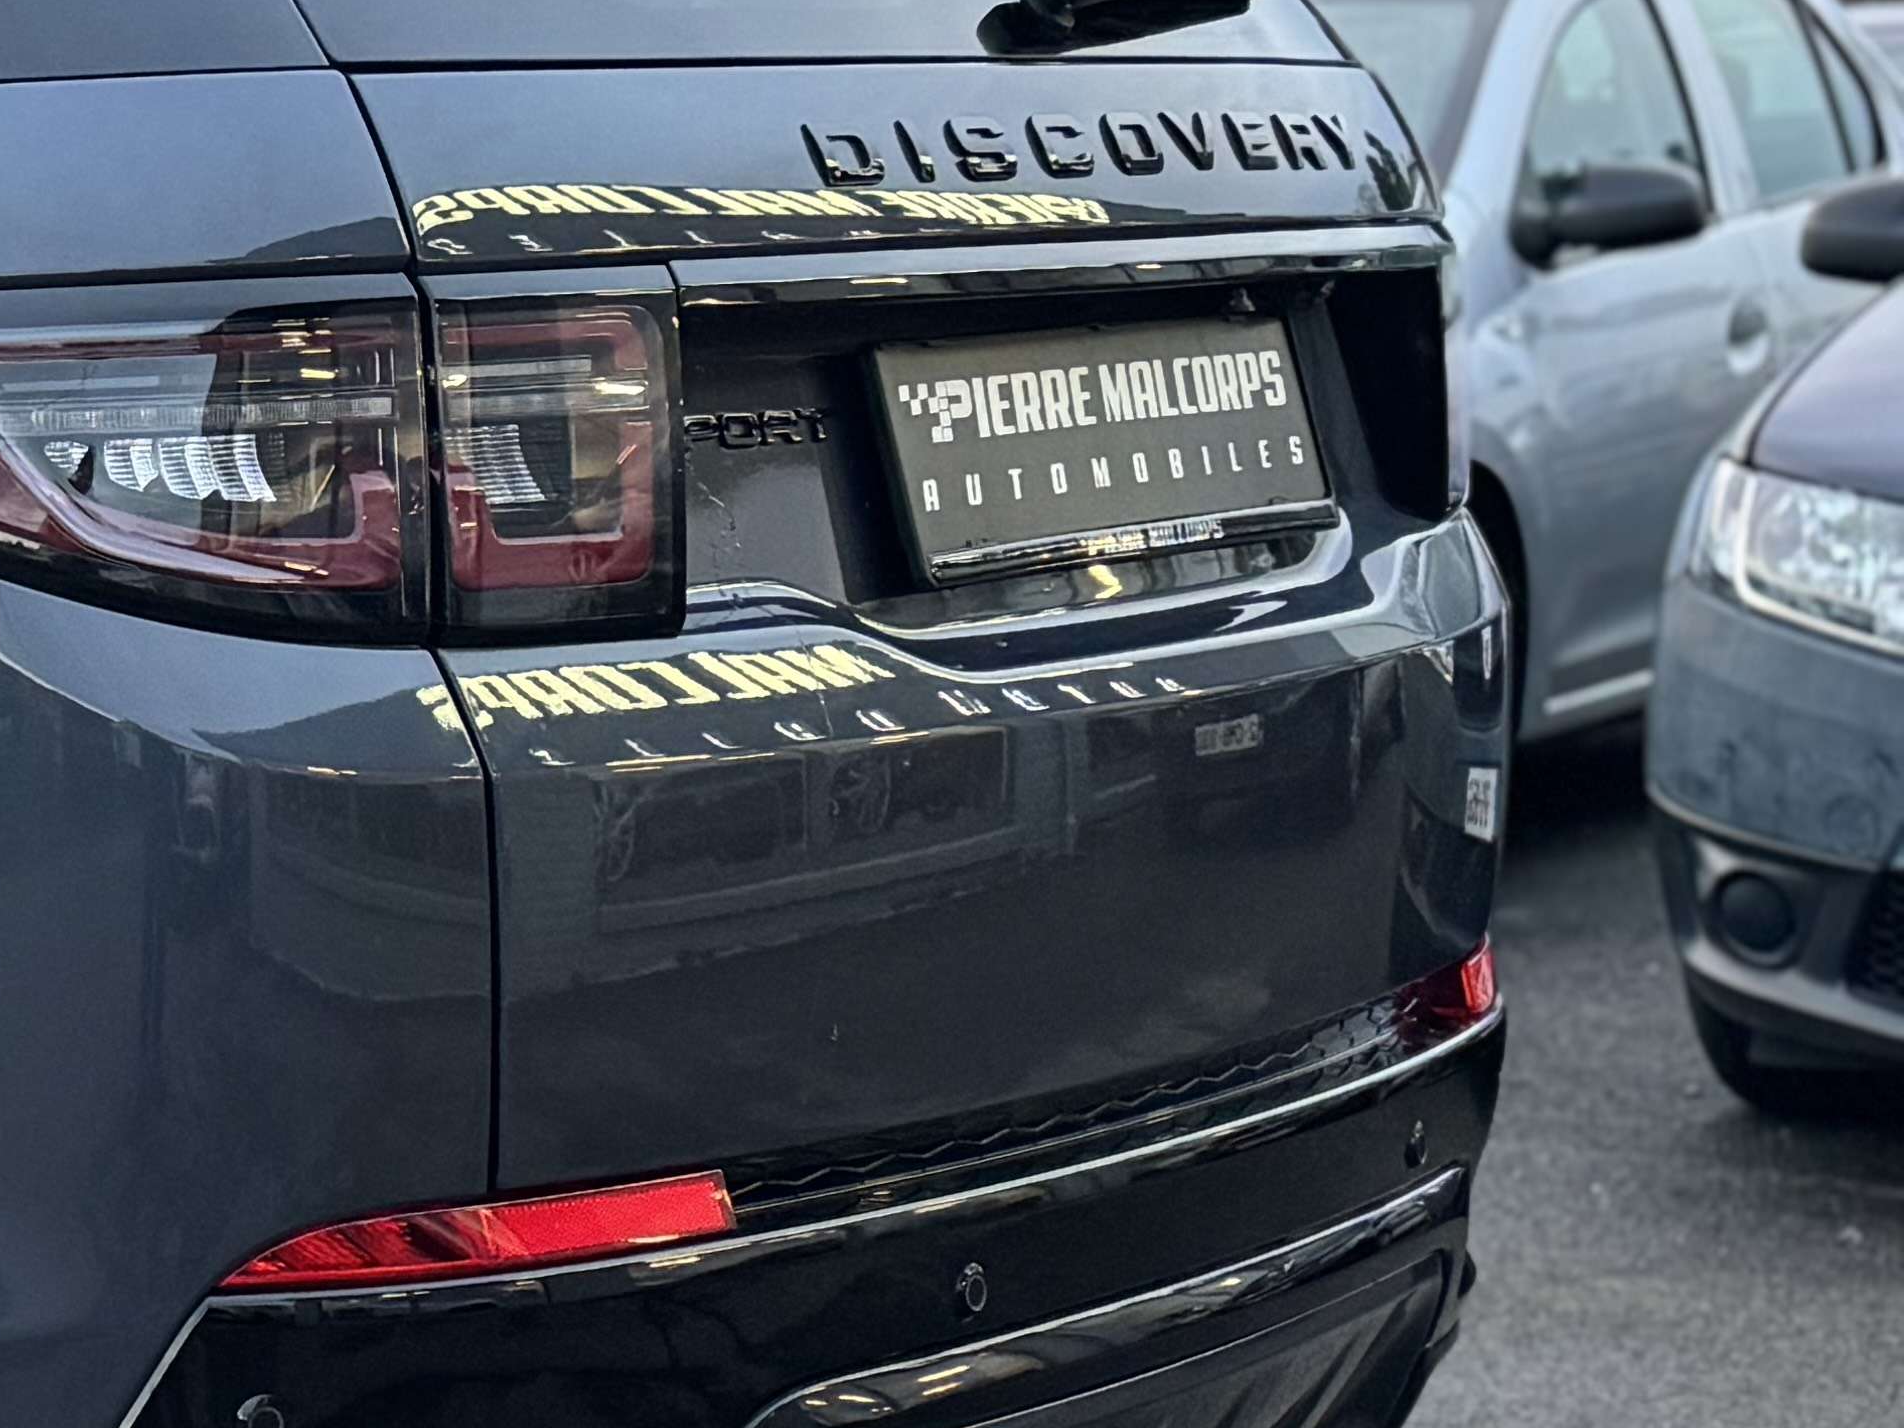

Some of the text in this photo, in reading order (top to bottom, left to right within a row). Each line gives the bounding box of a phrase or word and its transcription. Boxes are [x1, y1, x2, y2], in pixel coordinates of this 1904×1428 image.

[800, 111, 1356, 188] DISCOVERY
[682, 408, 827, 449] PORT
[930, 349, 1287, 443] PIERRE MALCORPS
[922, 435, 1304, 513] AUTOMOBILES
